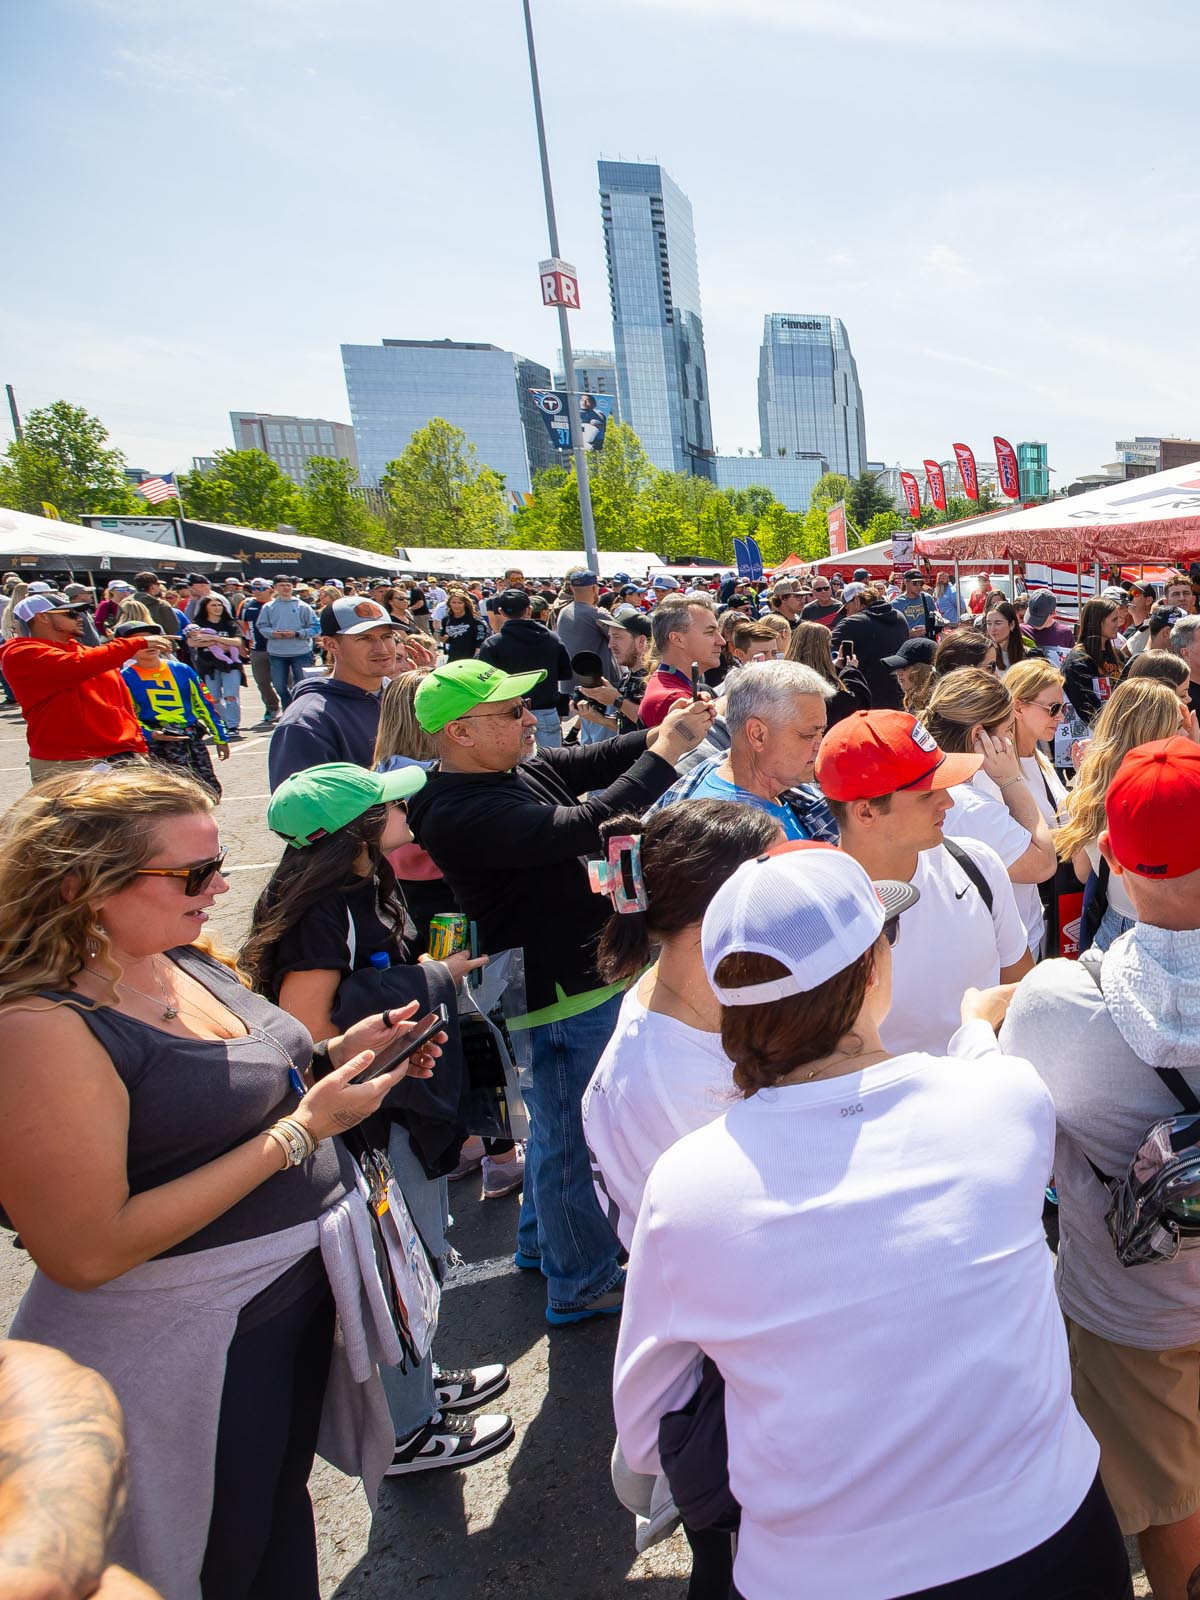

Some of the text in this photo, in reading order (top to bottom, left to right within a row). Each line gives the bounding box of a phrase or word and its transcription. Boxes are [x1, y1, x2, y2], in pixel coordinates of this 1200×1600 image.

[542, 275, 557, 303] R
[560, 275, 577, 306] R
[781, 317, 822, 330] Pinnacle
[141, 680, 188, 724] FOX
